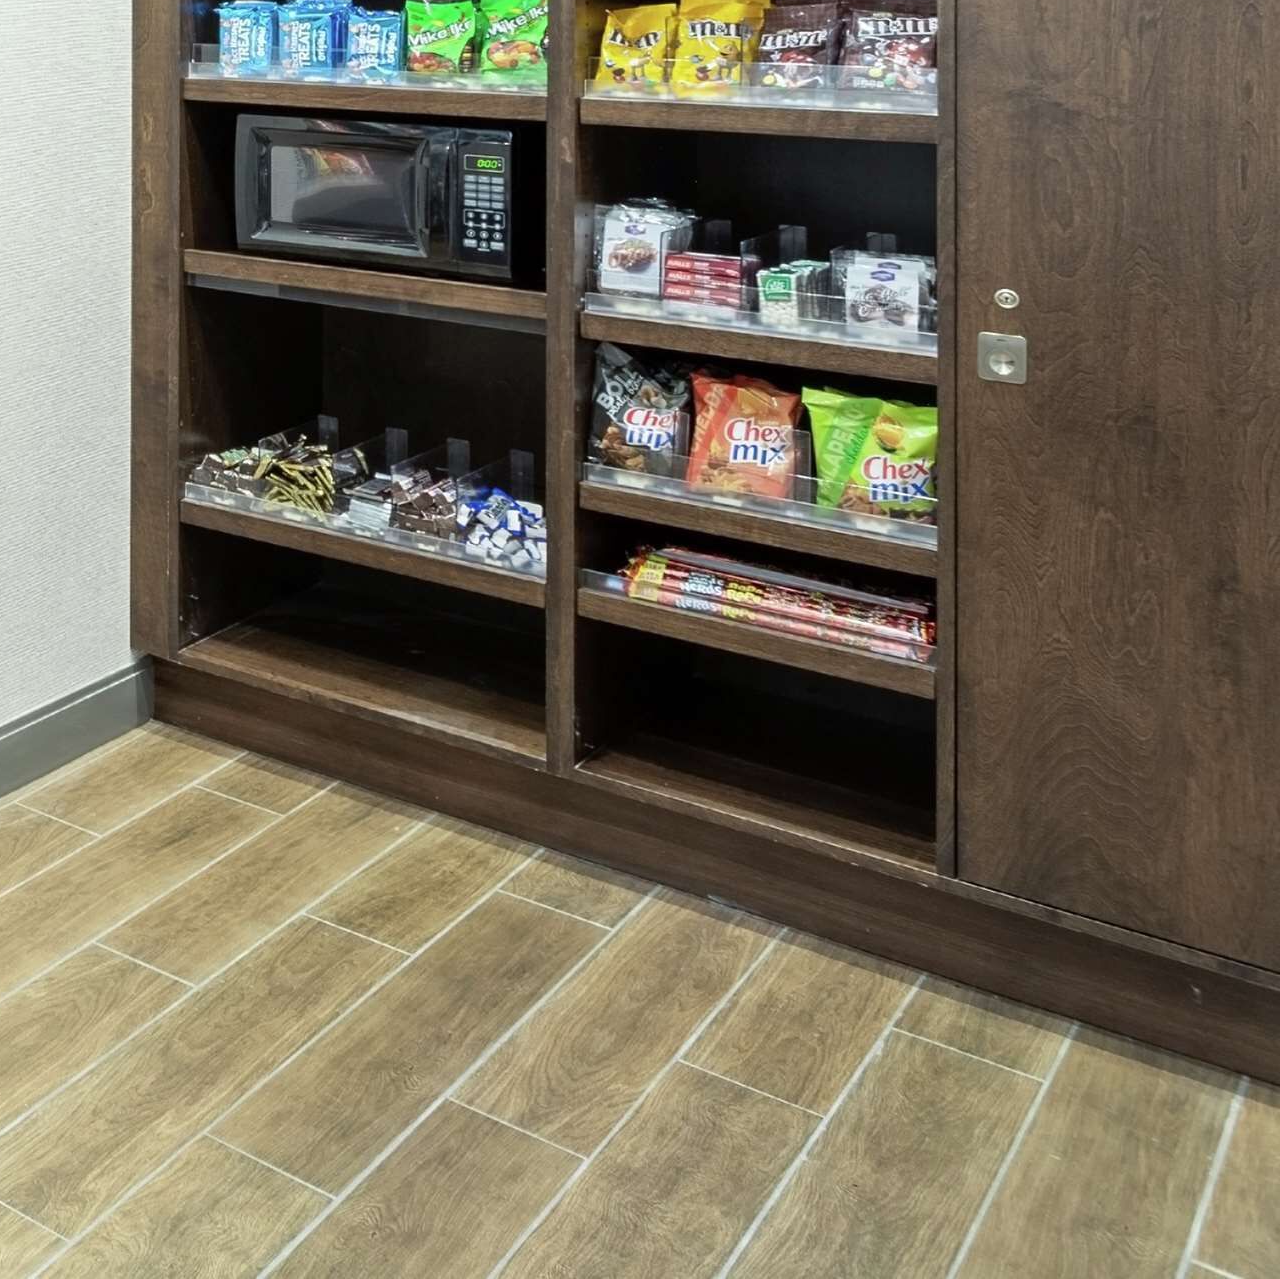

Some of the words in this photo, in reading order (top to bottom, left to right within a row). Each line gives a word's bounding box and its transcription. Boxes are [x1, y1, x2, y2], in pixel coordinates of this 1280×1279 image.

[299, 22, 312, 68] TREATS
[726, 418, 789, 443] Chex
[731, 442, 786, 466] mix
[863, 456, 930, 481] Chex
[870, 478, 930, 504] mix
